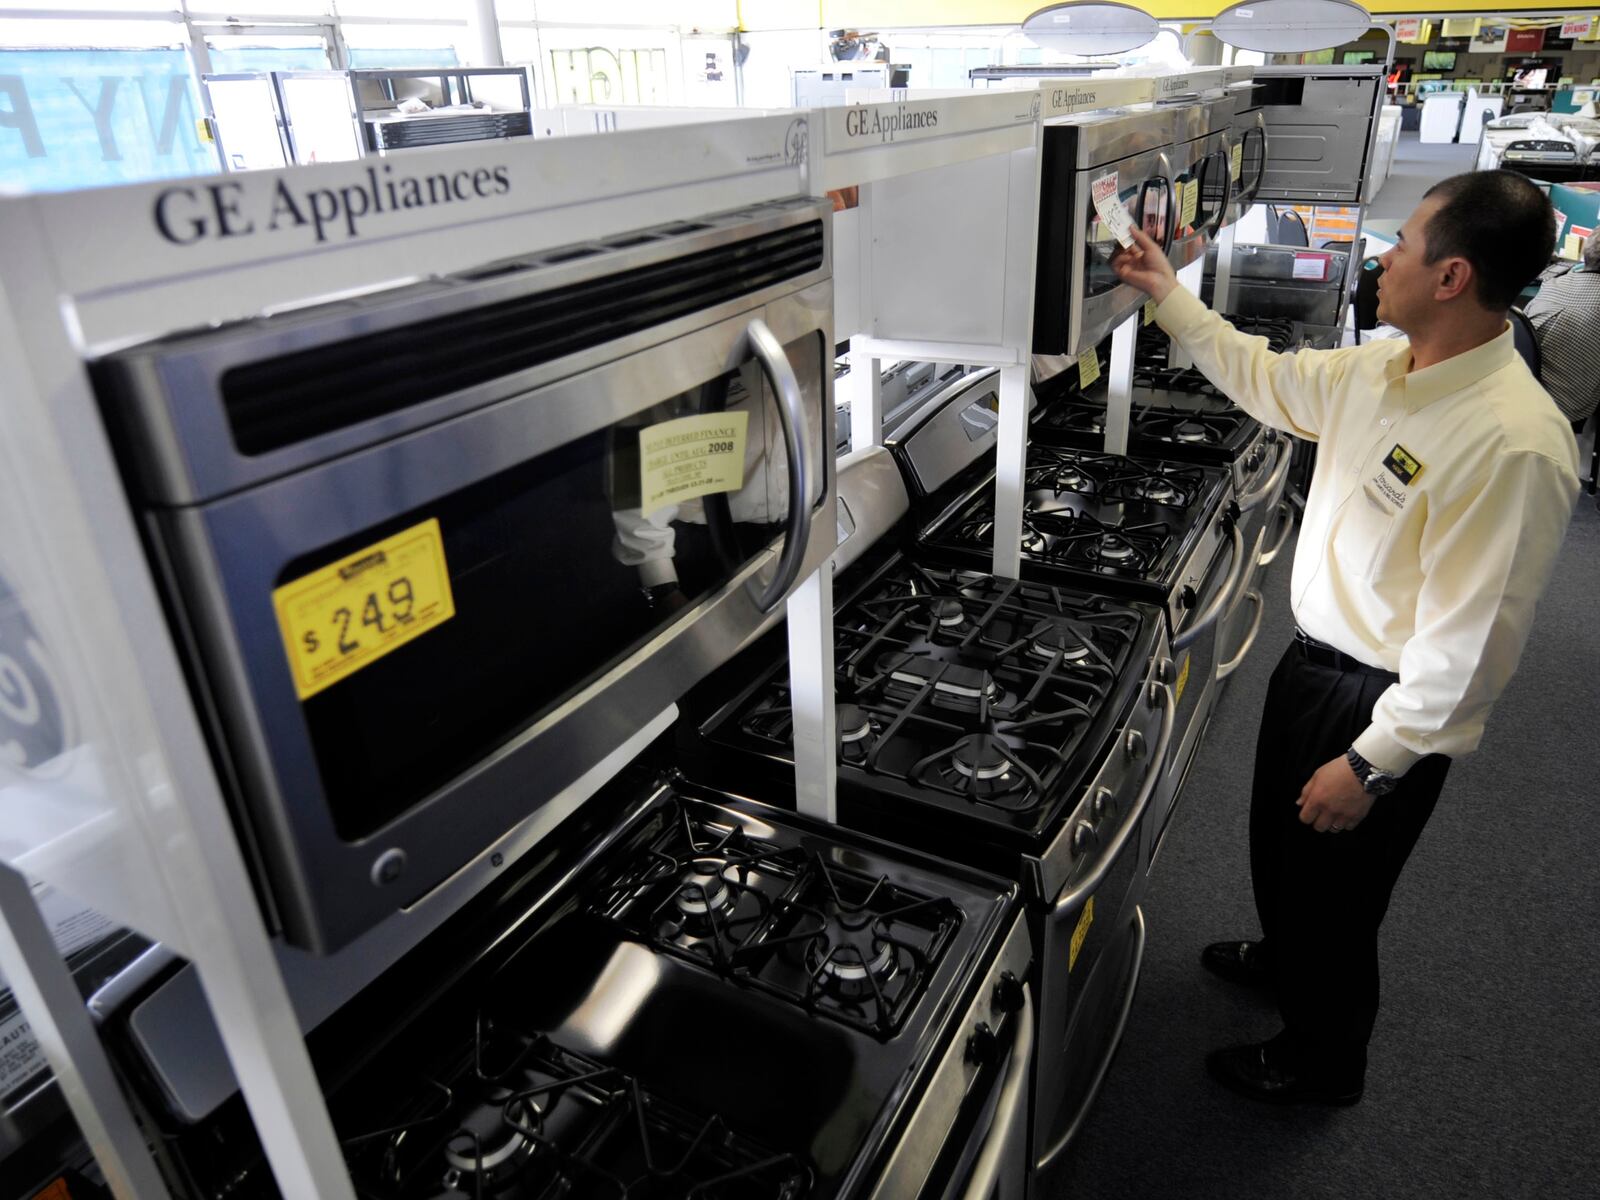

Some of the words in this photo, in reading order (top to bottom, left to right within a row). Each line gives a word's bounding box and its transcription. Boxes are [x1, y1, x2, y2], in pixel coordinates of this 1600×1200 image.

[1052, 89, 1064, 109] GE
[1063, 89, 1097, 113] Appliances
[846, 109, 869, 137] GE
[871, 105, 938, 144] Appliances
[153, 179, 257, 248] GE
[266, 163, 511, 243] Appliances
[700, 427, 737, 438] FINANCE
[707, 441, 735, 454] 2008
[1376, 471, 1407, 503] Howard's
[303, 629, 321, 653] $
[332, 576, 415, 655] 249
